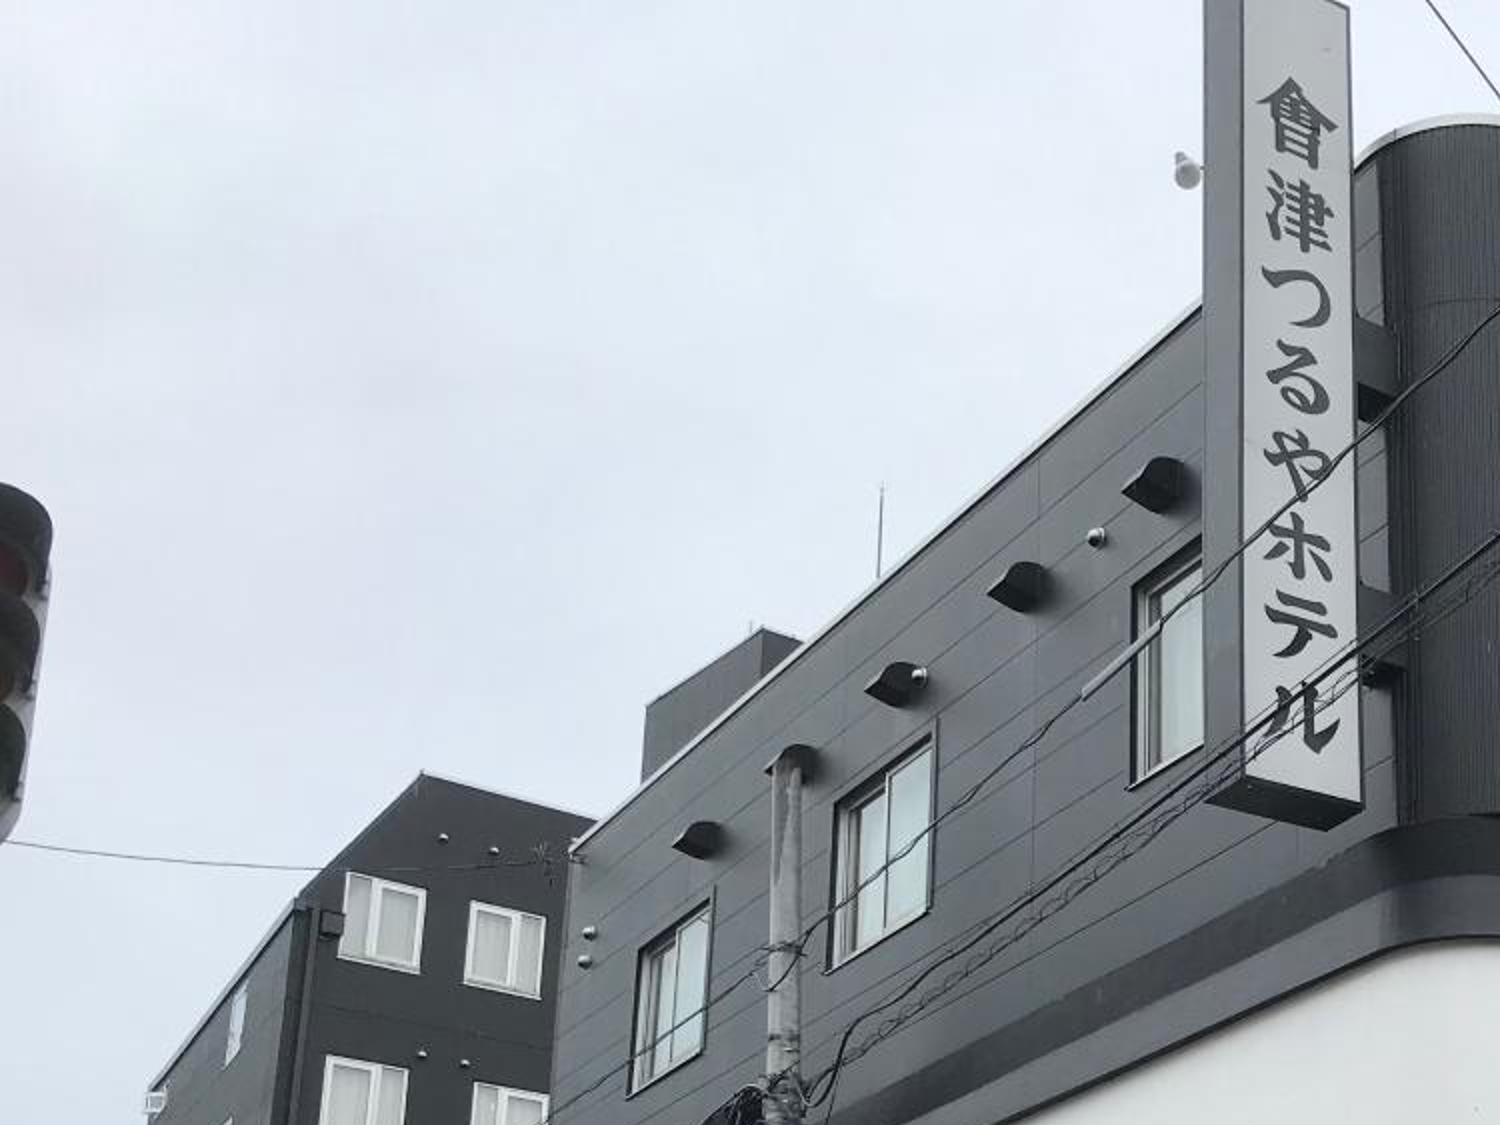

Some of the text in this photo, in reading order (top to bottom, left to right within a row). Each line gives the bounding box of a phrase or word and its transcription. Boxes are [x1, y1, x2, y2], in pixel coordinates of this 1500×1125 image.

[1256, 76, 1340, 756] 會津つるやホテル
